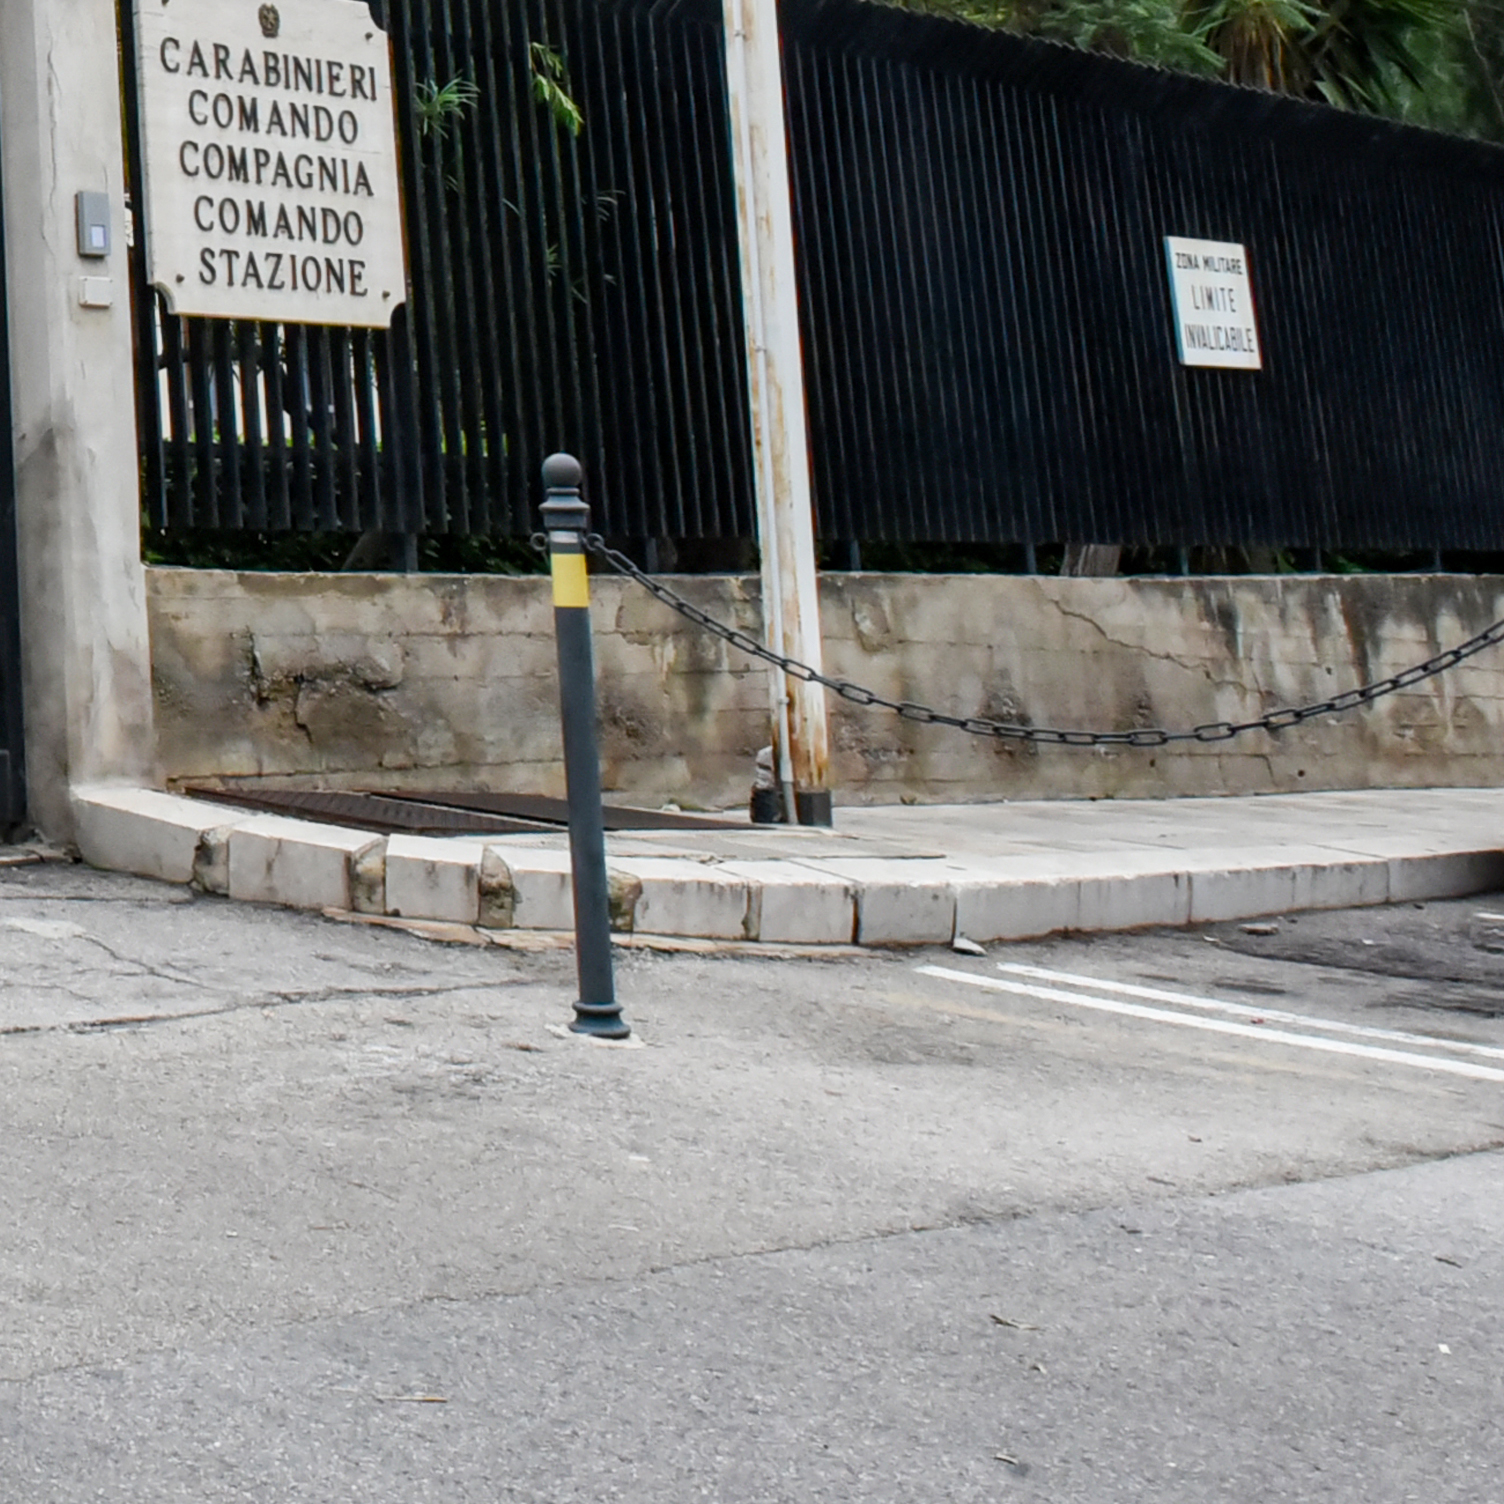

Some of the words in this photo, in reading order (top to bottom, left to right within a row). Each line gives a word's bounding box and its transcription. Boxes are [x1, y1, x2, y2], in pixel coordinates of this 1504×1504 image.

[159, 37, 378, 102] CARABINIERI
[188, 89, 359, 144] COMANDO
[179, 141, 374, 197] COMPAGNIA
[194, 195, 364, 246] COMANDO
[198, 248, 368, 297] STAZIONE
[1174, 252, 1200, 270] ZONA
[1202, 254, 1244, 275] MILITARE
[1191, 284, 1236, 313] LIMITE
[1184, 323, 1256, 354] INVALICABILE
